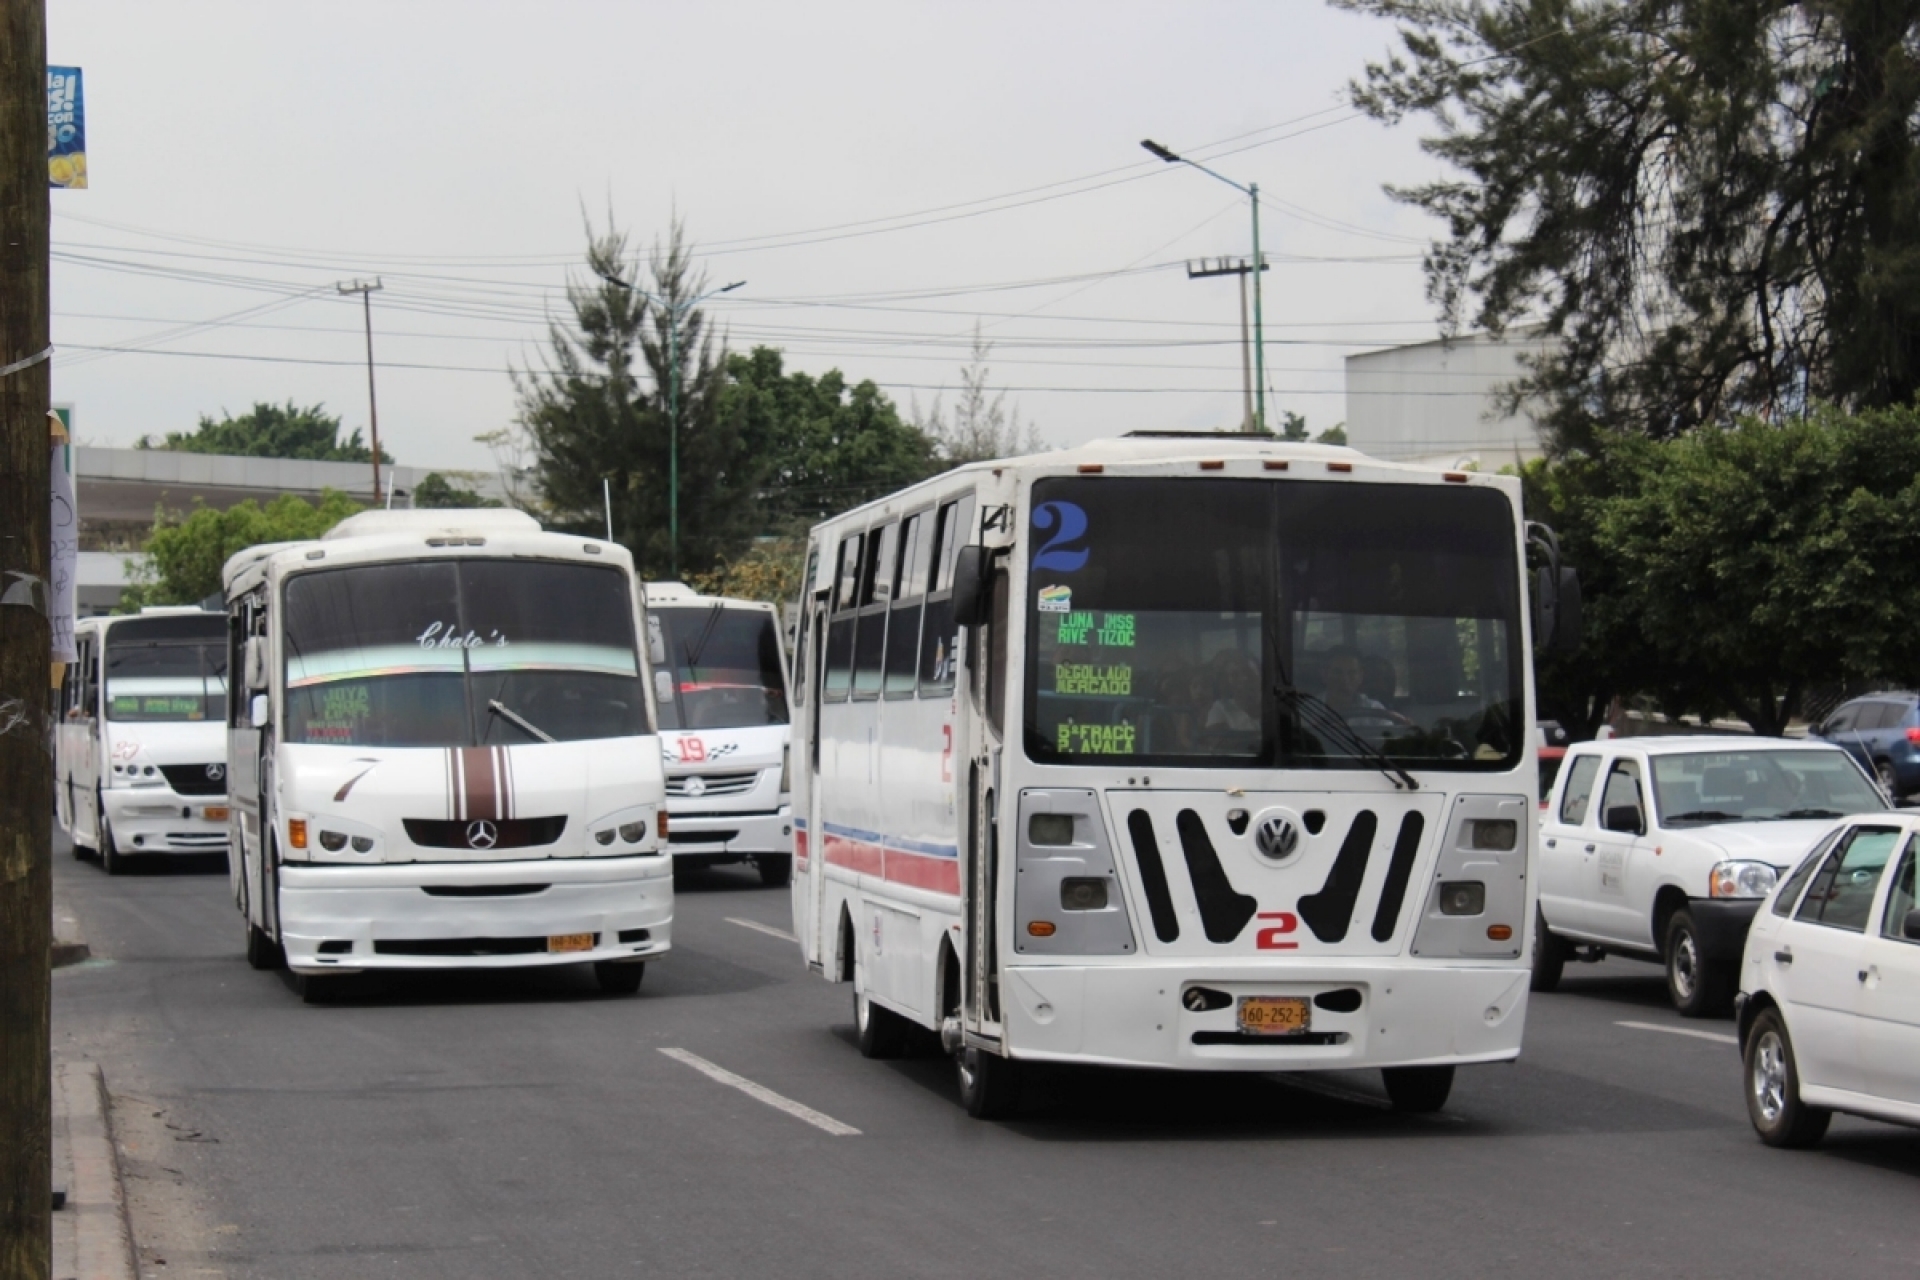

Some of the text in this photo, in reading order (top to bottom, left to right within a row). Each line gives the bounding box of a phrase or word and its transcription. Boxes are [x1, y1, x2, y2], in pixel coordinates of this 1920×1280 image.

[1032, 501, 1090, 572] 2
[1060, 612, 1135, 630] LUNA IMSS
[416, 621, 509, 649] Chato's
[1097, 628, 1136, 647] TIZOC
[1056, 664, 1132, 681] DEGOLLADO
[1056, 680, 1131, 695] MERCADO
[677, 738, 706, 762] 19
[1081, 738, 1134, 754] AYALA
[333, 757, 383, 803] 7
[1256, 912, 1299, 950] 2
